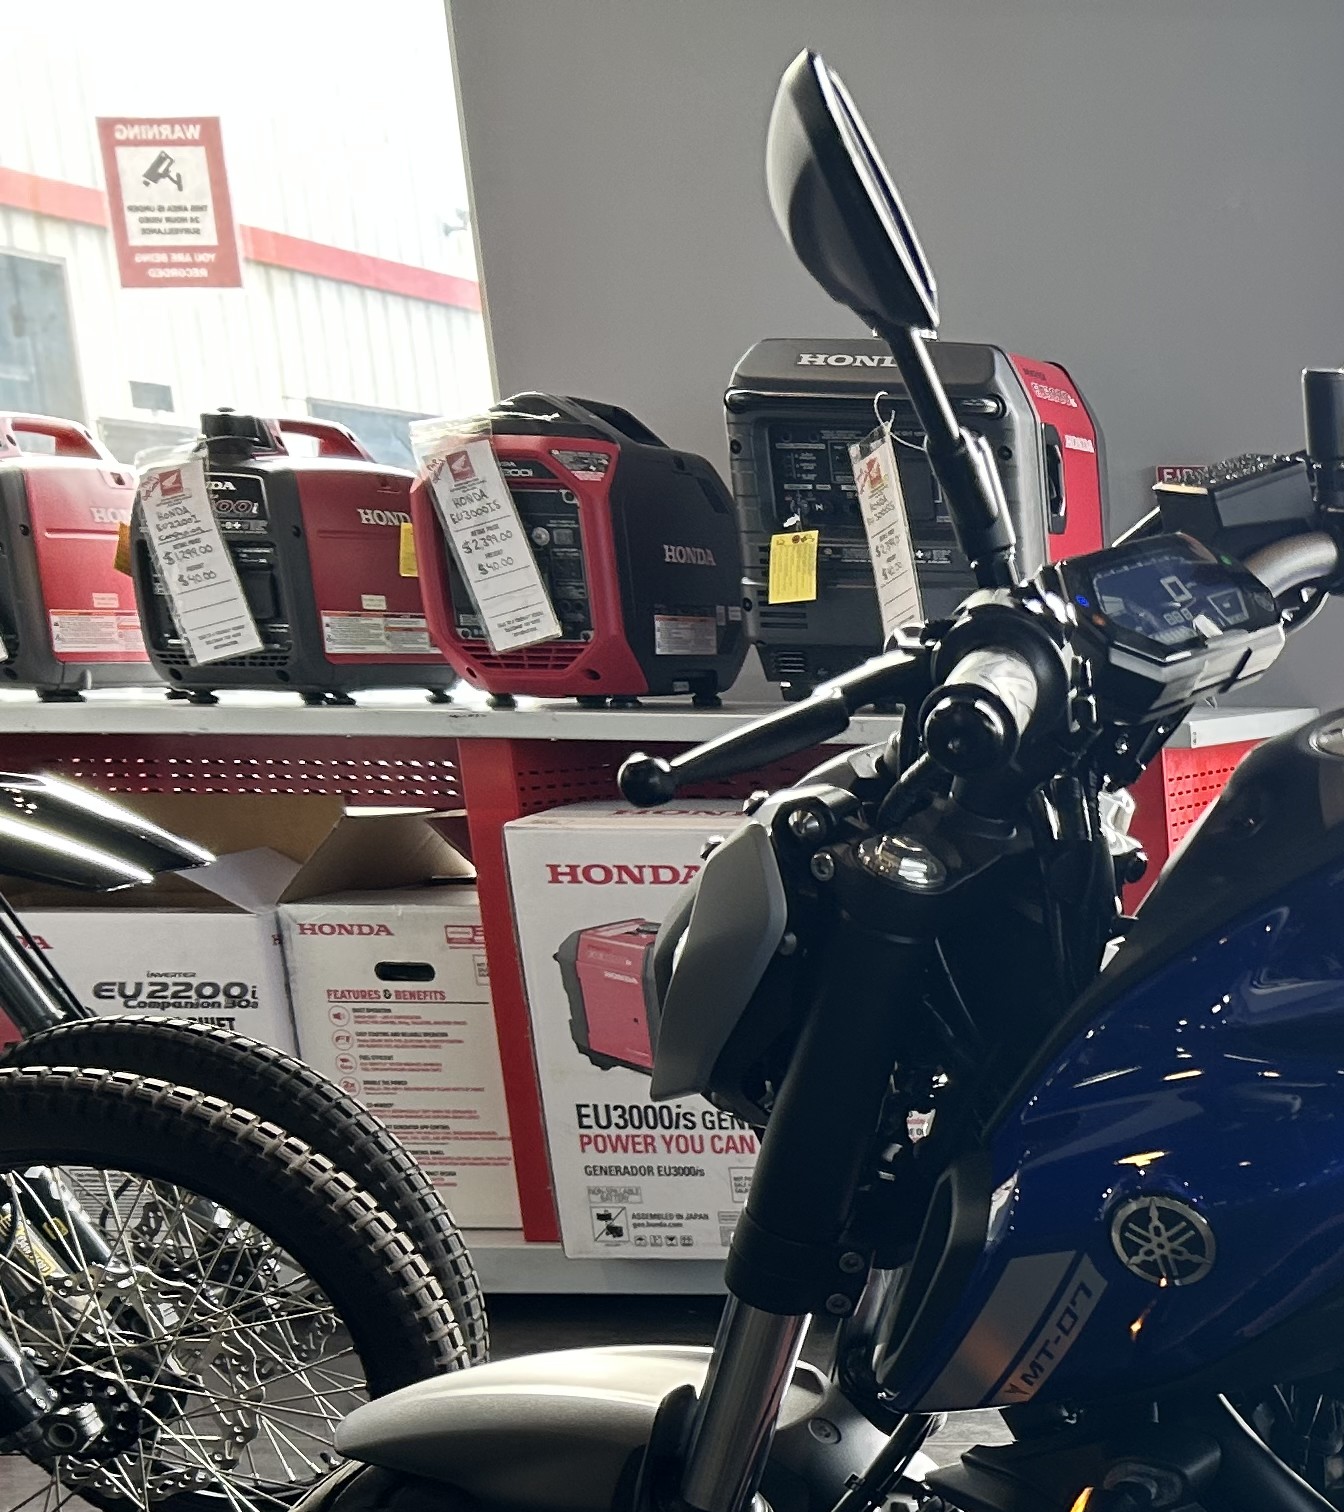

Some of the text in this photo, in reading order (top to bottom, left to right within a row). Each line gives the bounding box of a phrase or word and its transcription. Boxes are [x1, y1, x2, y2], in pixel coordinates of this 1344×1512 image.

[357, 508, 411, 527] HOND
[663, 544, 717, 567] HONDA
[296, 922, 395, 937] HONDA
[92, 982, 259, 1000] EU2200i
[327, 988, 447, 1001] FEATURES & BENEFITS
[575, 1103, 697, 1131] EU3000is
[579, 1134, 756, 1155] POWER YOU CAN
[584, 1164, 655, 1177] GENERADOR
[1019, 1281, 1093, 1388] MT-07
